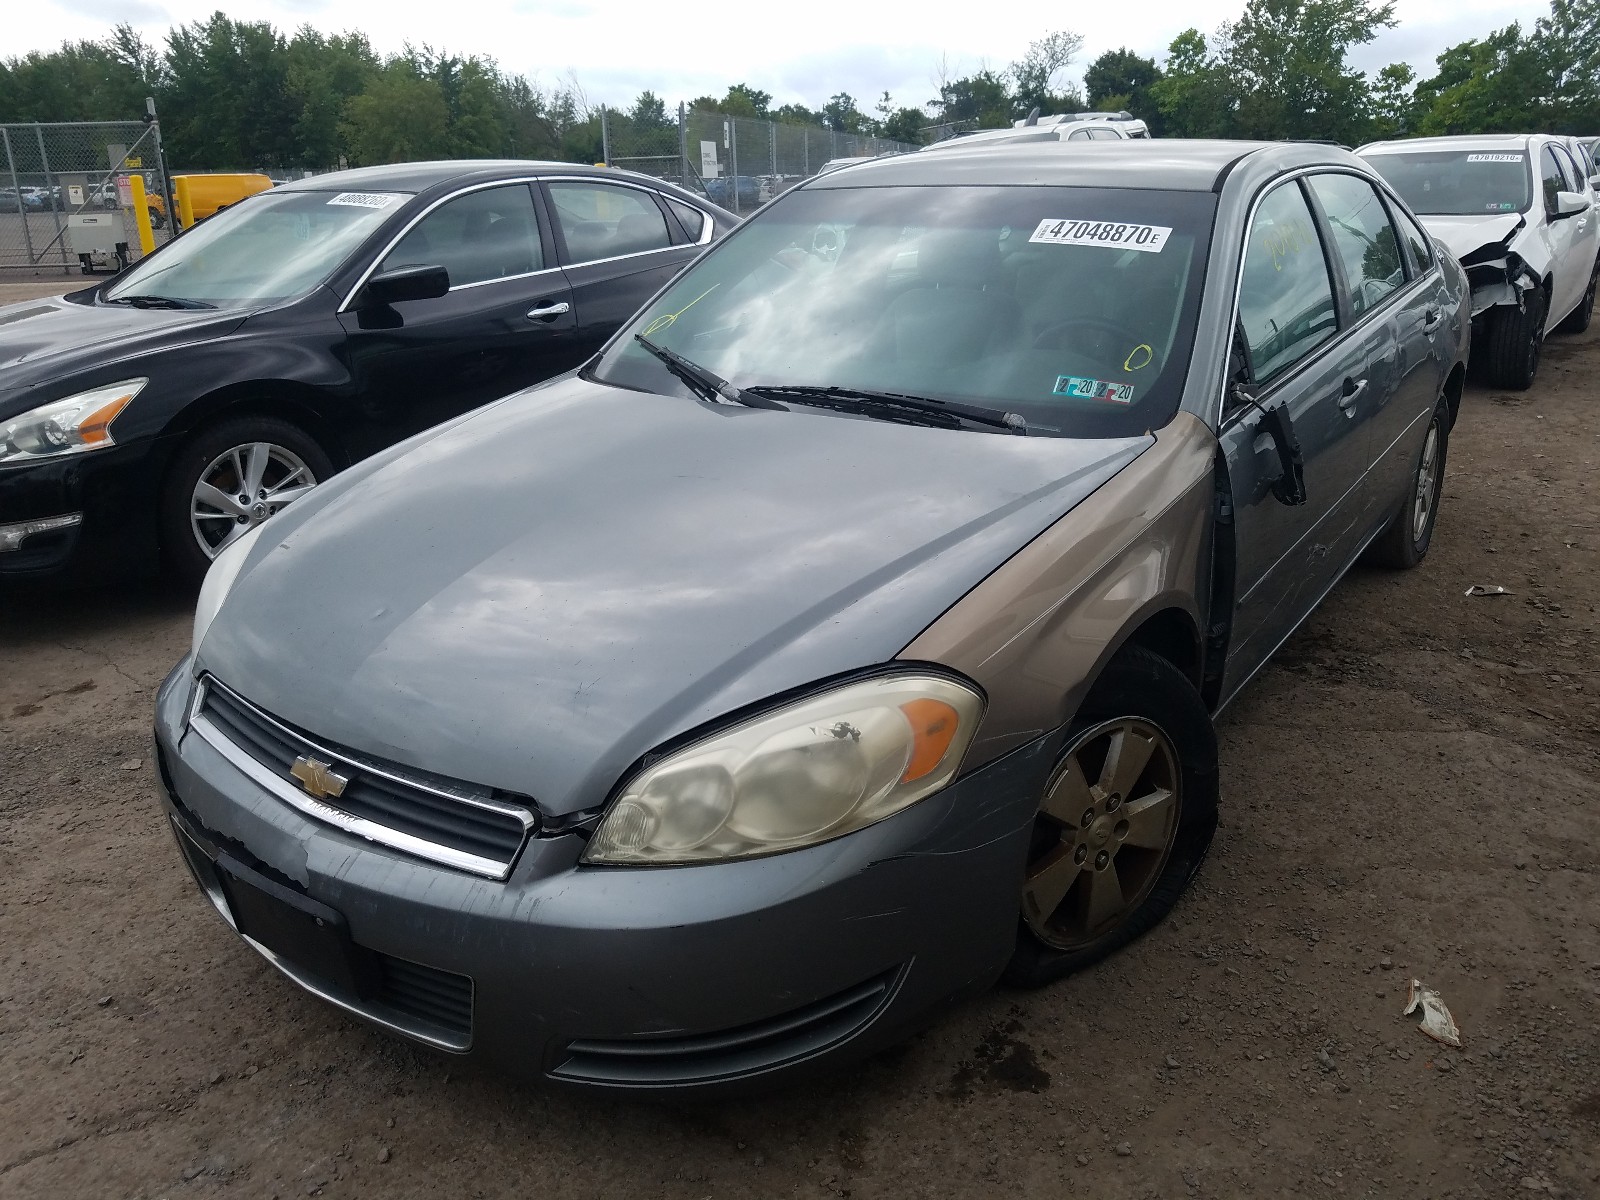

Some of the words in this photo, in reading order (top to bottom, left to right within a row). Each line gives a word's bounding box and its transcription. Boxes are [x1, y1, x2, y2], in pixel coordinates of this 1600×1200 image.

[1059, 378, 1069, 393] 2
[1079, 379, 1093, 394] 20
[1117, 385, 1132, 399] 20
